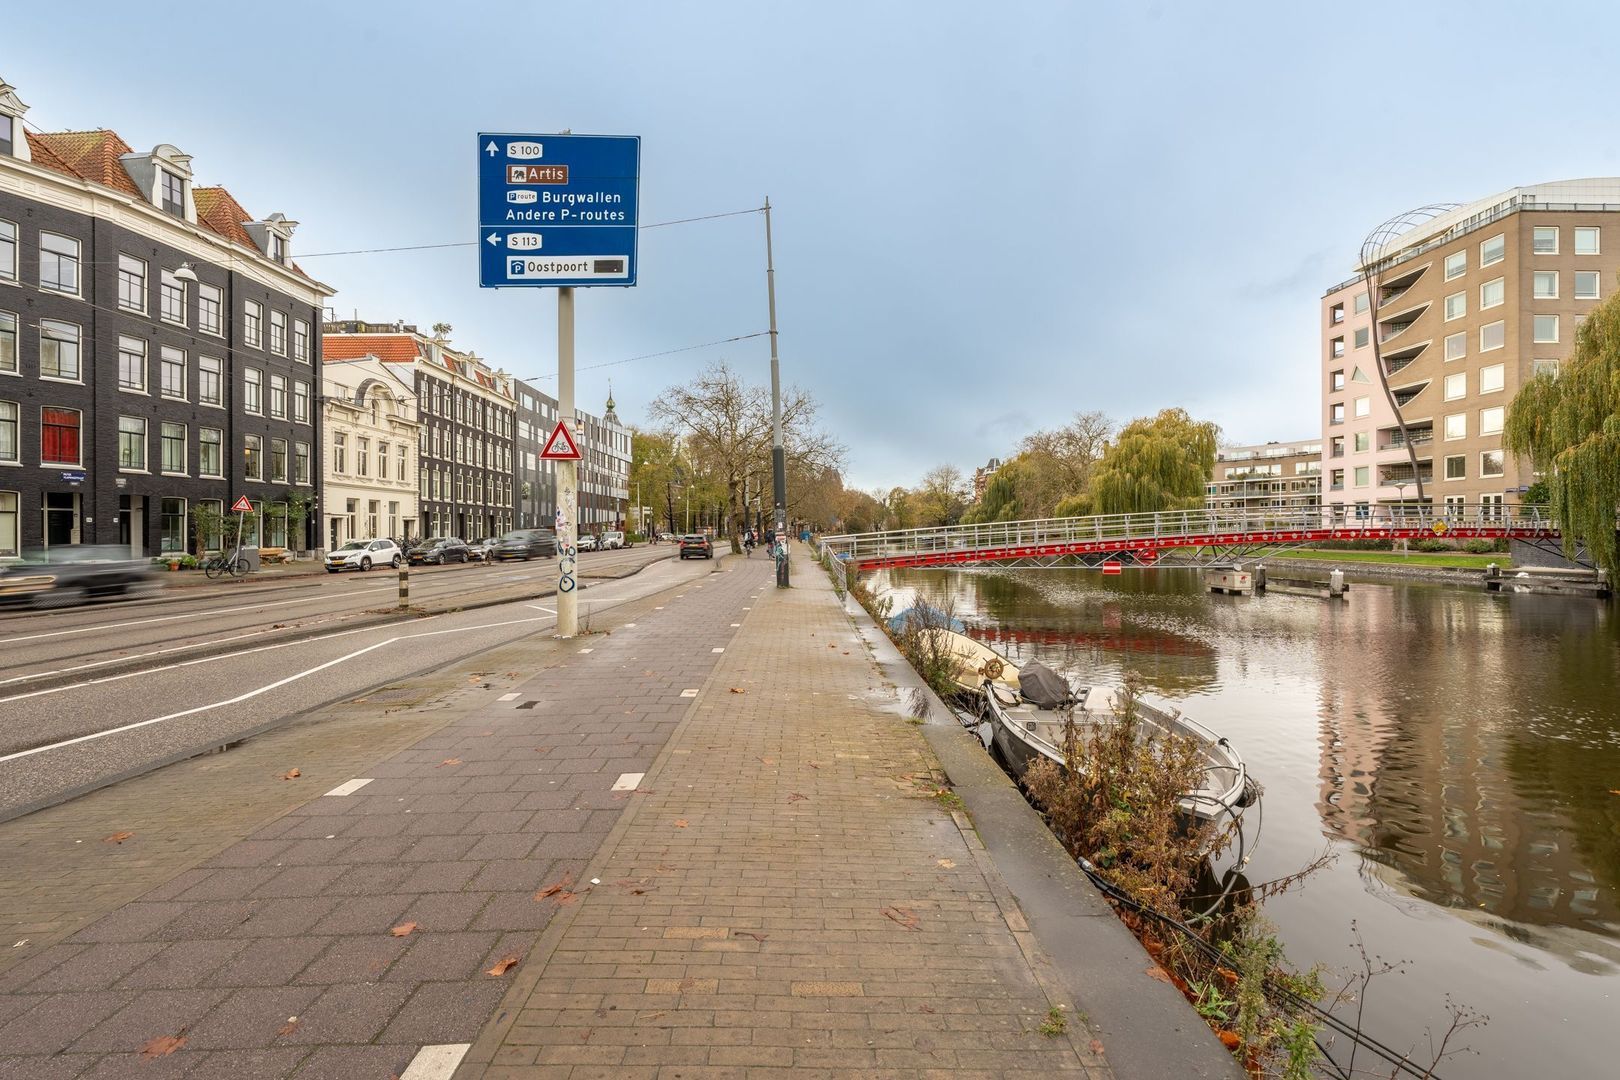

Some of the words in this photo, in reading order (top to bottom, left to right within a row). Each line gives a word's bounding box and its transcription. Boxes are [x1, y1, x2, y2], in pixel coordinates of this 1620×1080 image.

[510, 146, 517, 155] S
[521, 146, 540, 155] 100
[529, 168, 564, 180] Artis
[517, 192, 536, 200] route
[542, 191, 621, 206] Burgwallen
[506, 209, 556, 221] Andere
[561, 209, 625, 221] P-routes
[511, 237, 519, 246] S
[522, 237, 538, 246] 113
[527, 261, 588, 273] Oostpoort
